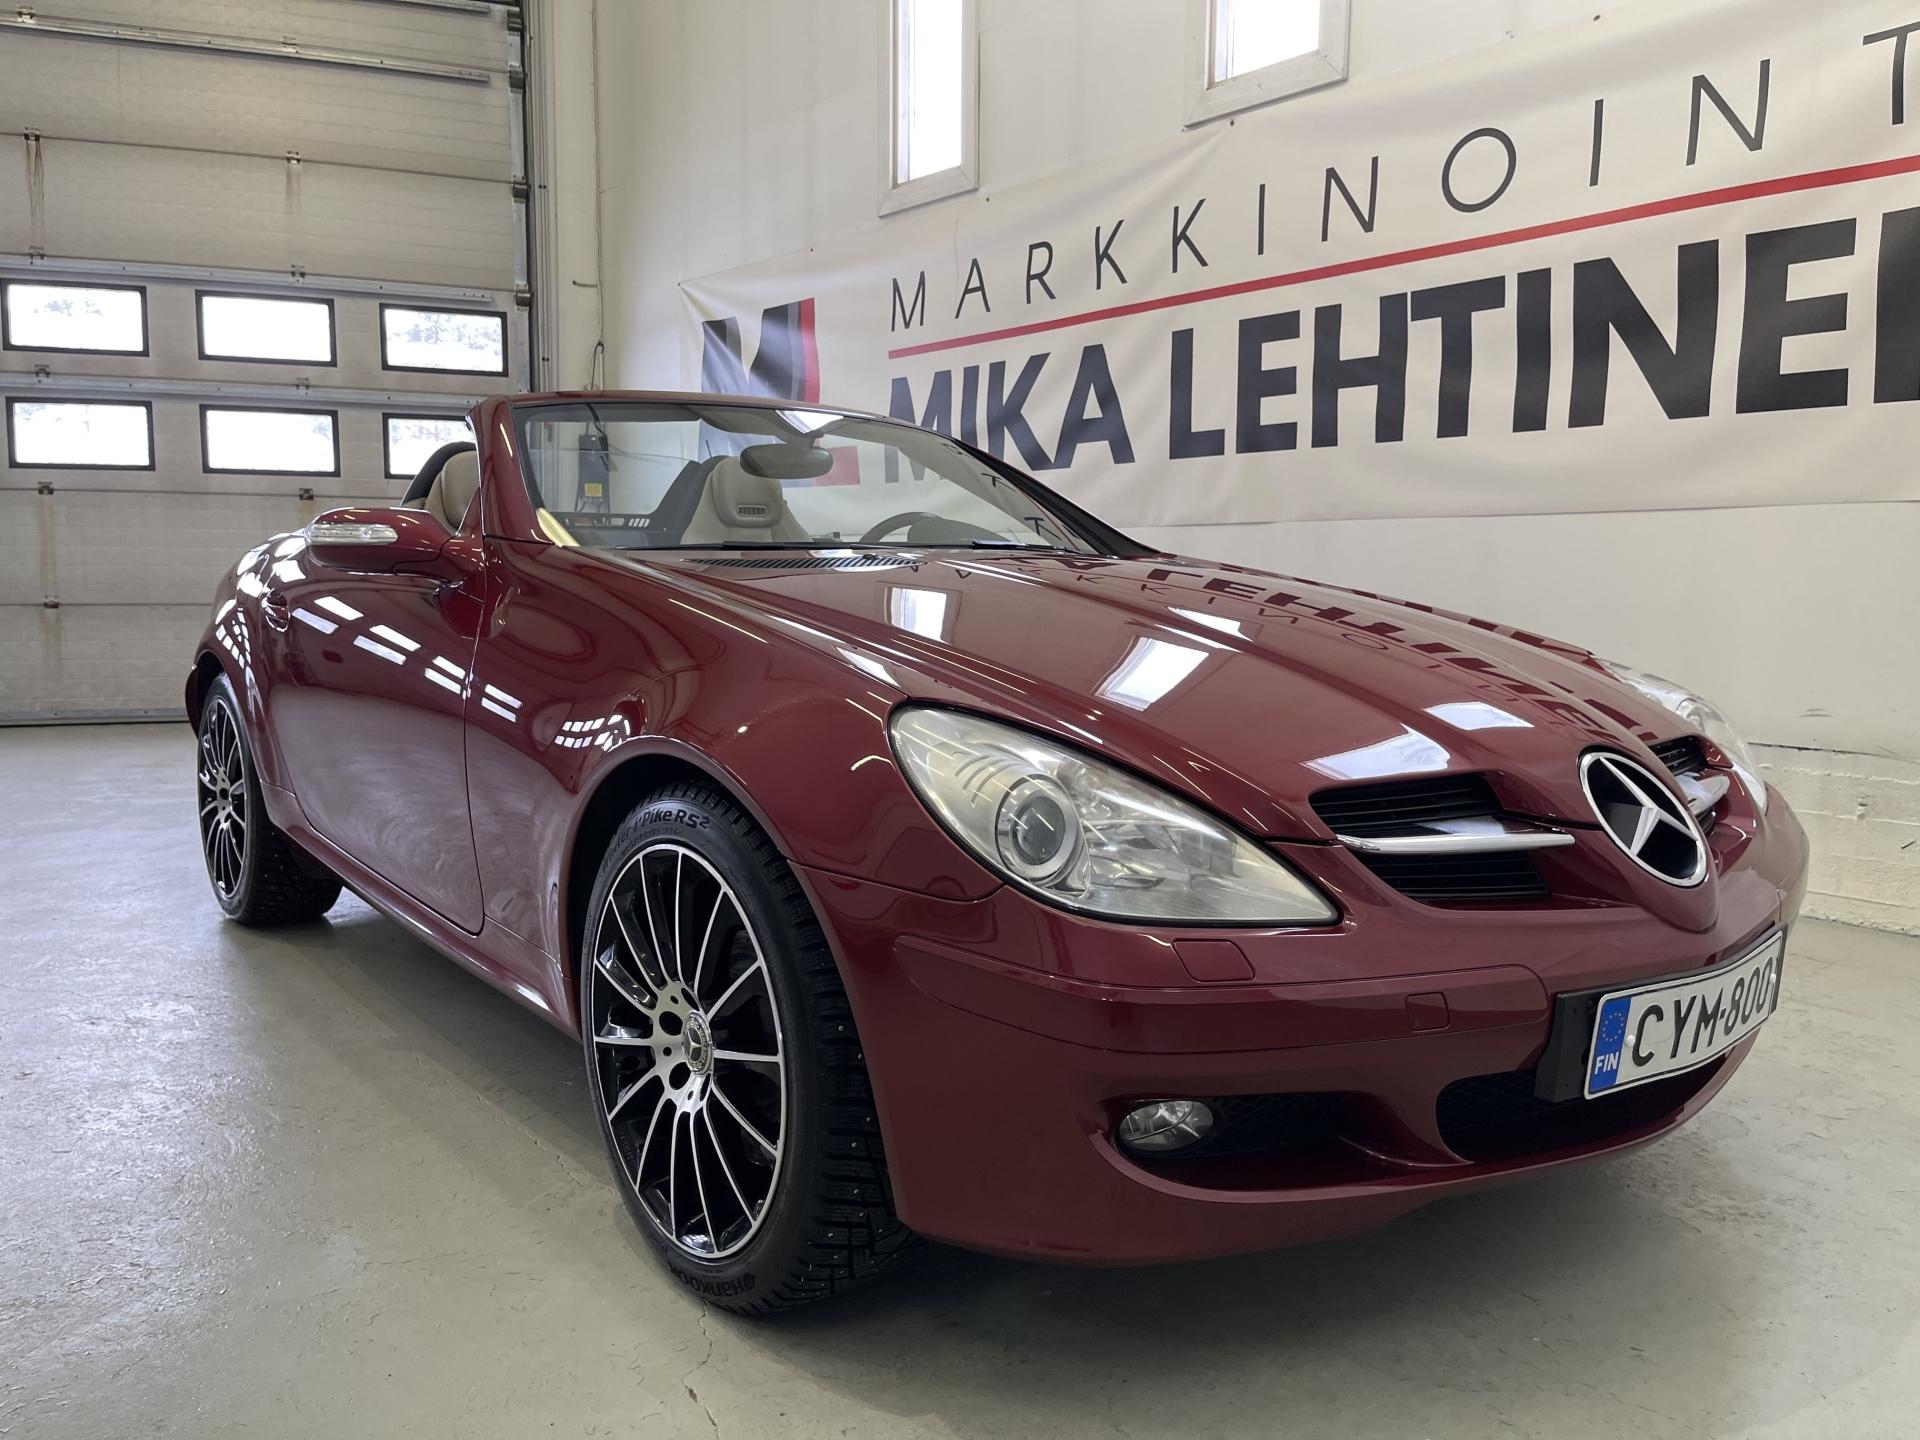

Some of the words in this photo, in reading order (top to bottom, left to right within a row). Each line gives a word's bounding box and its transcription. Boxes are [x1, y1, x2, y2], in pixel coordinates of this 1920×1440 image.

[886, 343, 1135, 484] MIKA
[1594, 1051, 1619, 1074] FIN
[1632, 957, 1773, 1067] CYM-800
